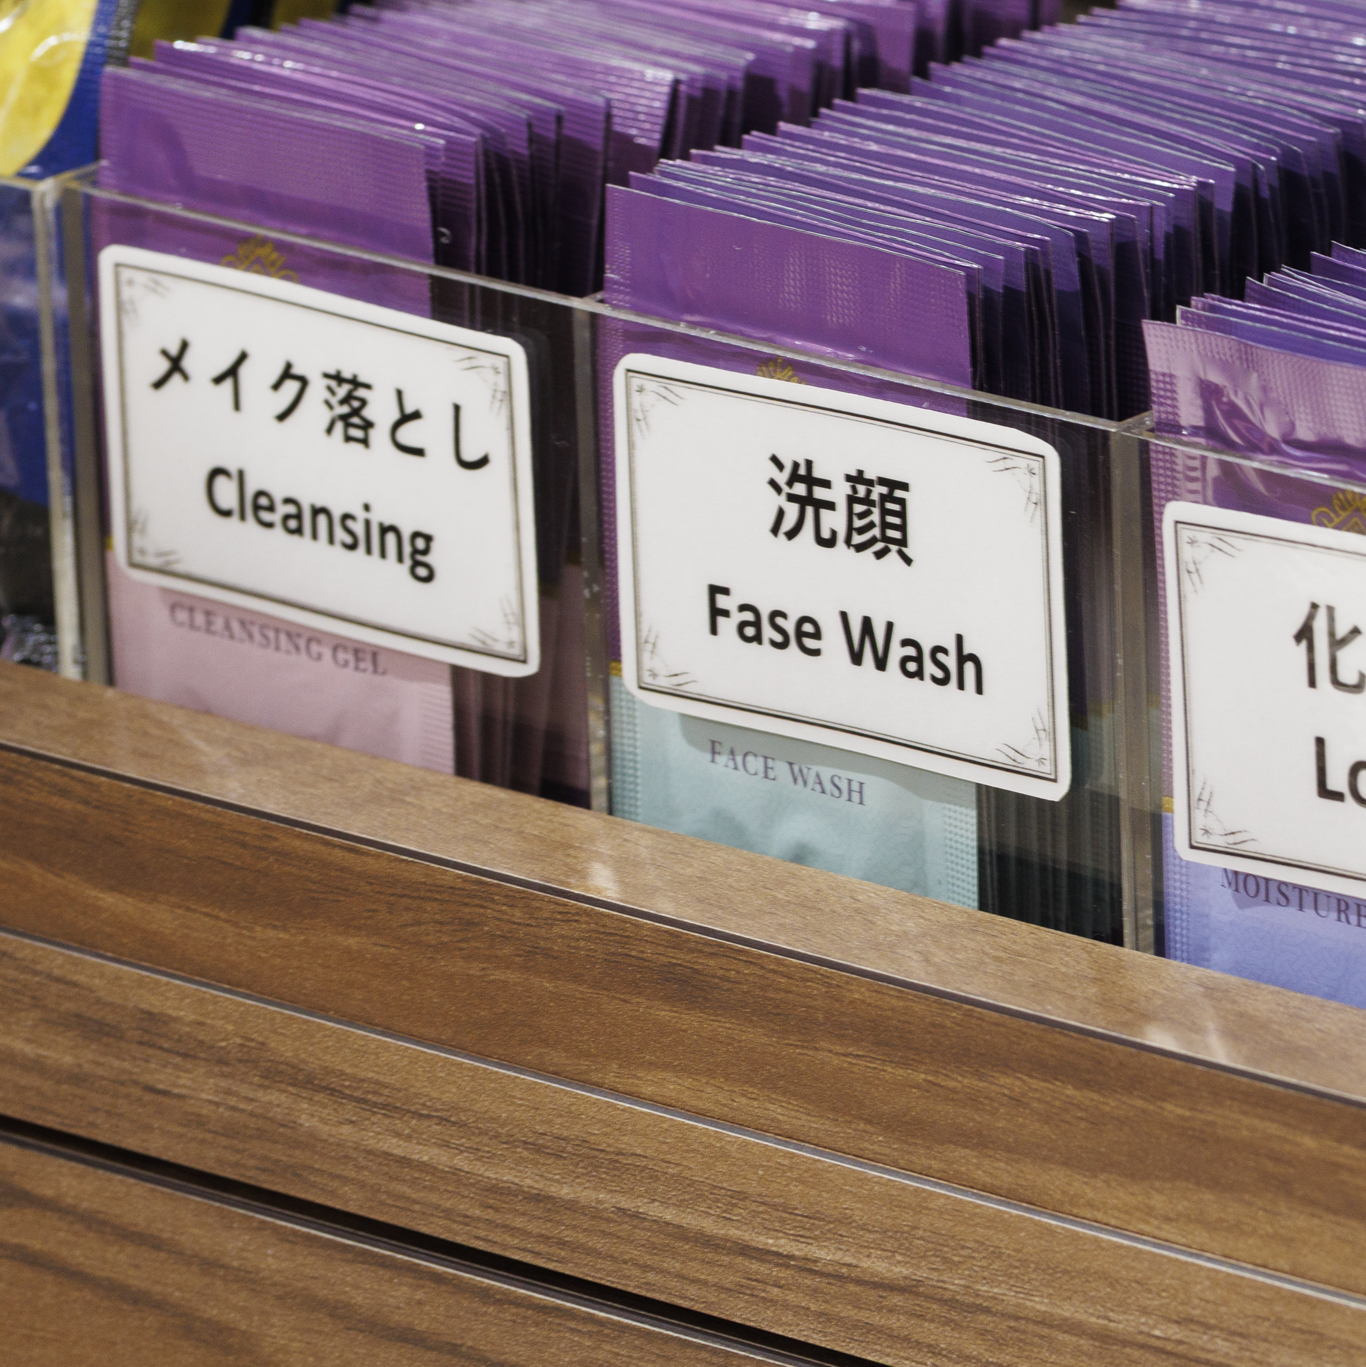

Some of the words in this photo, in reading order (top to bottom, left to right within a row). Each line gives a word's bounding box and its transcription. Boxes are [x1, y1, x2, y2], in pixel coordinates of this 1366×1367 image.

[151, 337, 490, 471] メイク落とし
[206, 467, 437, 584] Cleansing
[767, 454, 914, 566] 洗顔
[169, 601, 324, 662] CLEANSING
[331, 642, 388, 676] GEL
[706, 584, 823, 658] Fase
[839, 609, 985, 696] Wash
[709, 739, 777, 782] FACE
[787, 760, 867, 807] WASH
